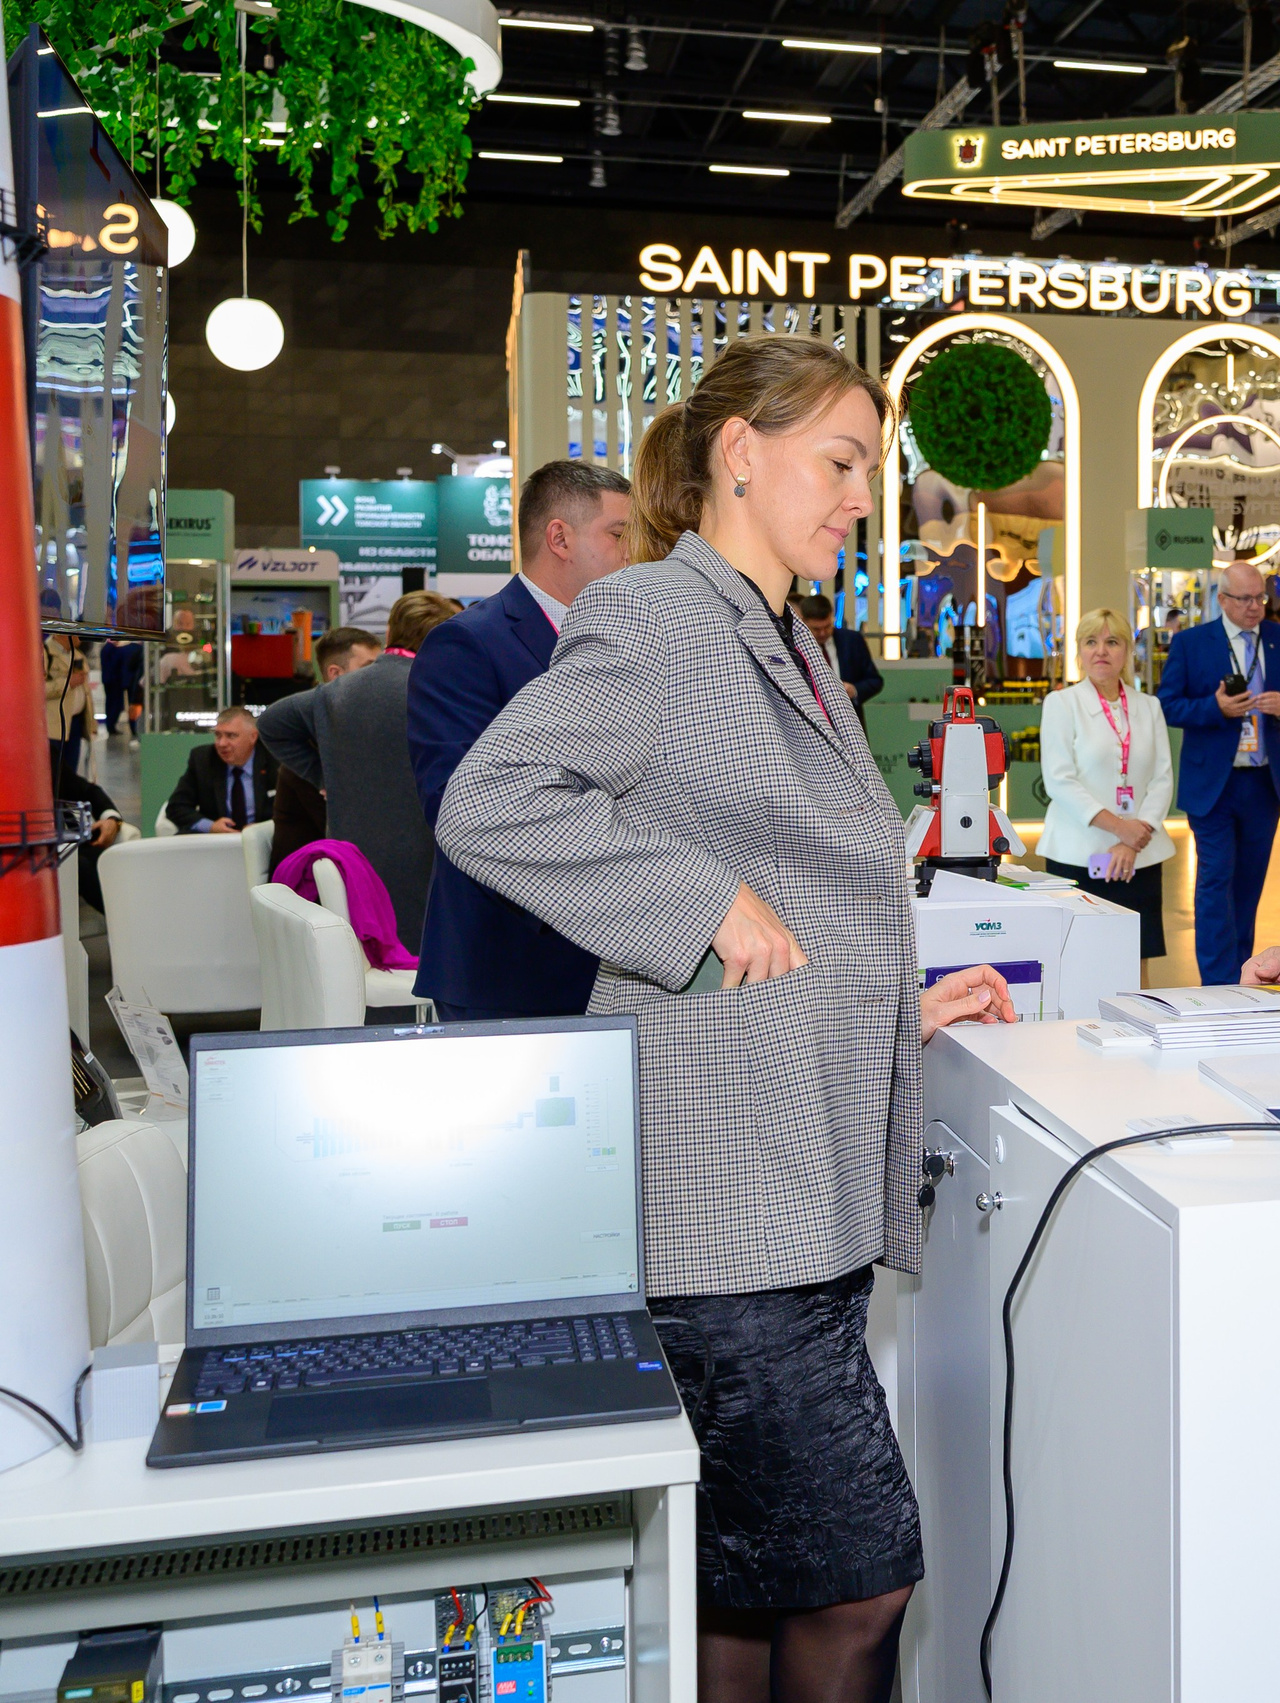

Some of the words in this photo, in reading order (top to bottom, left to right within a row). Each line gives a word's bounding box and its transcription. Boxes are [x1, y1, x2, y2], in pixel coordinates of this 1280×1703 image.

[1001, 136, 1070, 161] SAINT
[1075, 127, 1237, 156] PETERSBURG
[639, 243, 831, 302] SAINT
[849, 253, 1253, 317] PETERSBURG
